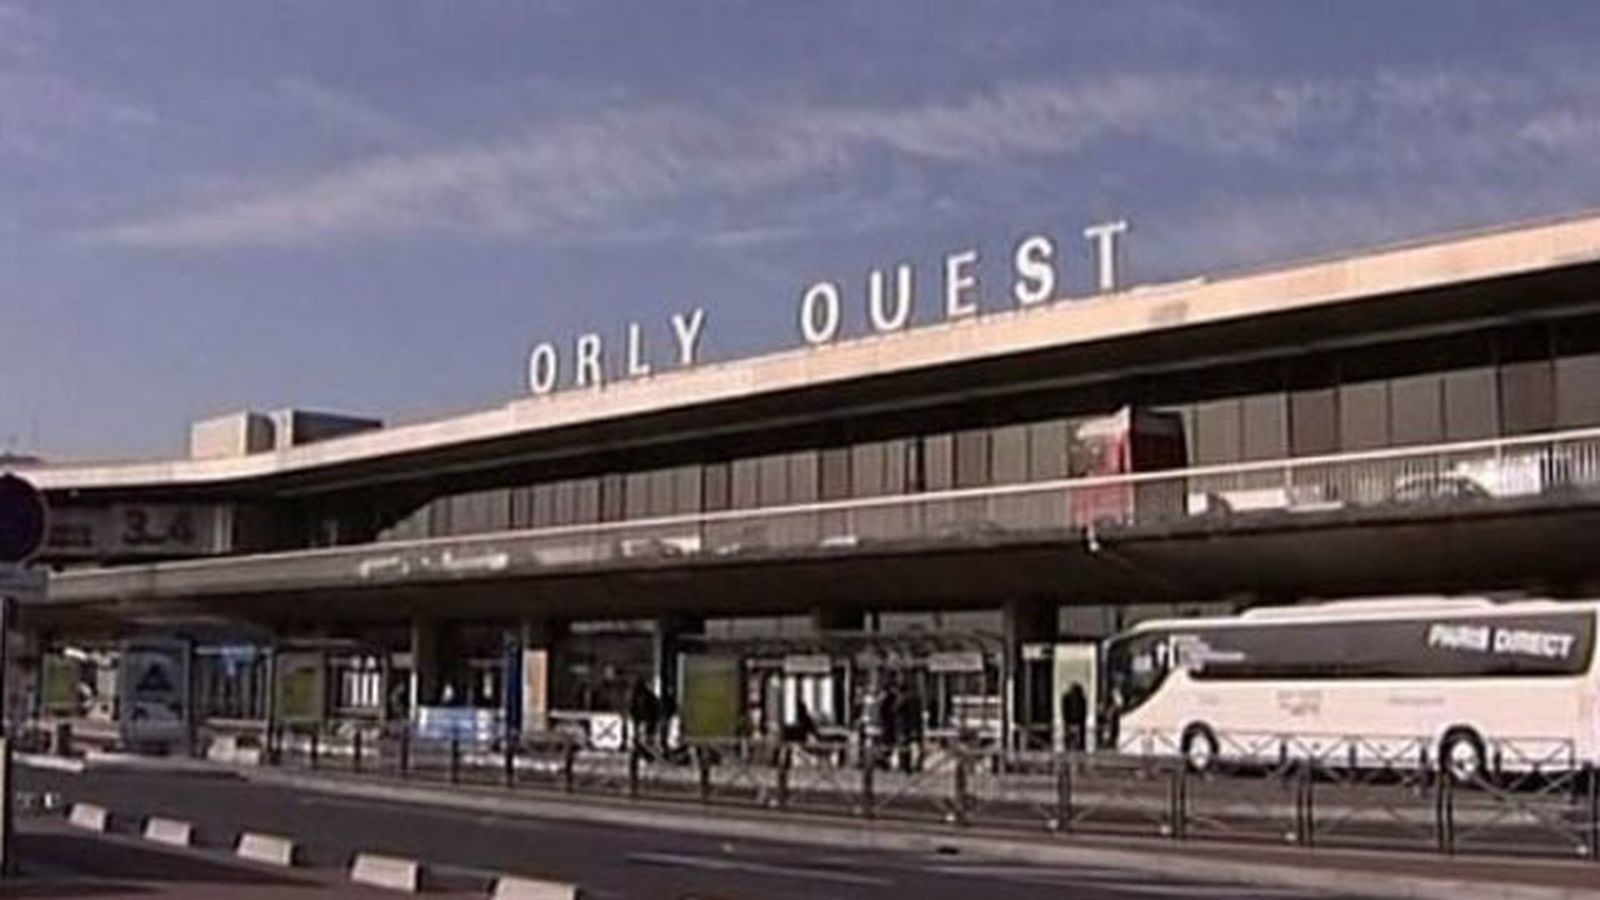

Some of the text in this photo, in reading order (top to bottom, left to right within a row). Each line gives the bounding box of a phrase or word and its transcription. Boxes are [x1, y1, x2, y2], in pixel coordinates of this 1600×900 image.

[530, 221, 1128, 395] ORLY OUEST
[1495, 629, 1574, 659] DIRECT
